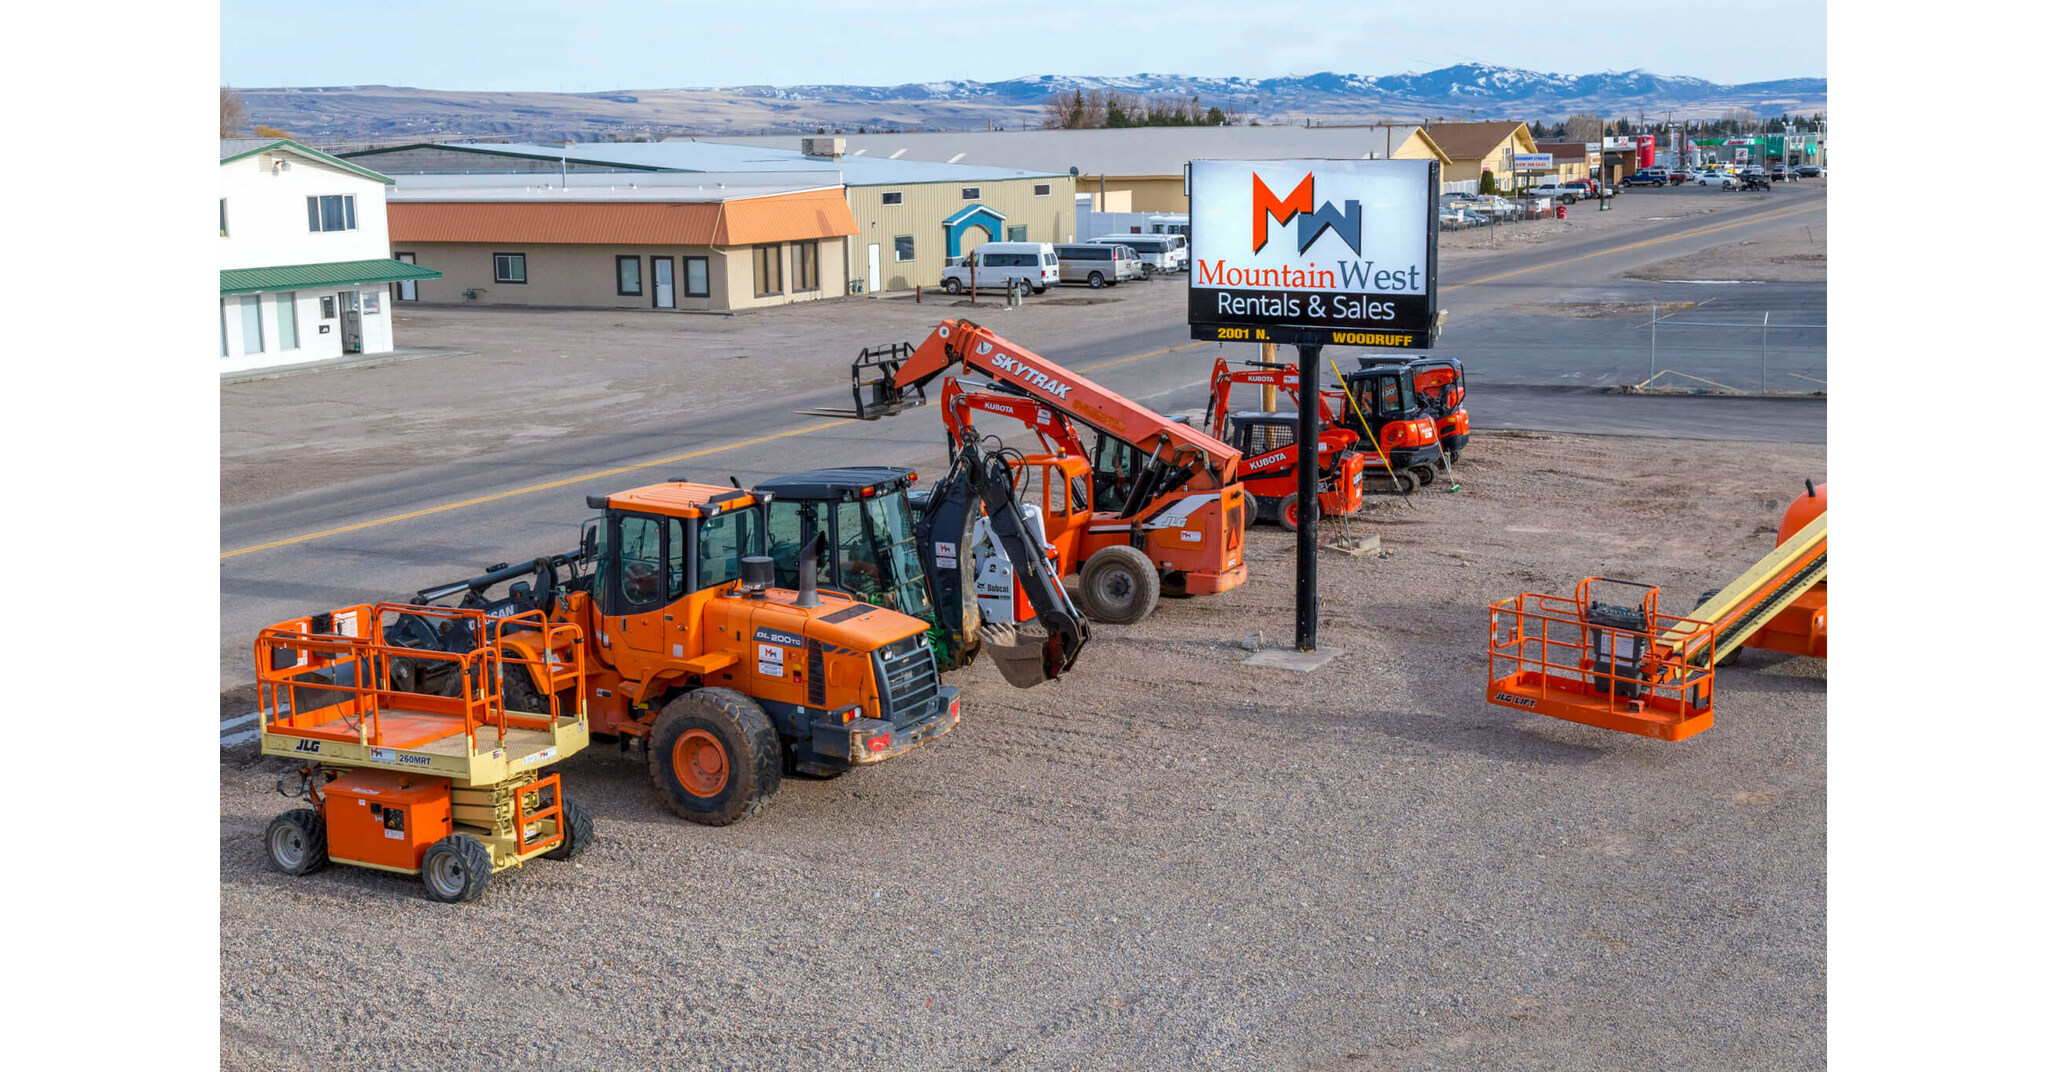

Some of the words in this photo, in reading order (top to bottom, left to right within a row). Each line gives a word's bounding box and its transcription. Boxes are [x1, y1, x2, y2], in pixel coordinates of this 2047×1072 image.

[1217, 292, 1300, 318] Rentals
[1307, 295, 1327, 319] &
[1332, 296, 1396, 321] Sales
[1217, 328, 1250, 340] 2001
[1255, 329, 1271, 341] N.
[1332, 332, 1413, 347] WOODRUFF
[991, 353, 1073, 400] SKYTRAK
[1247, 375, 1275, 383] KUBOTA
[984, 402, 1014, 414] KUBOTA
[1249, 452, 1287, 470] KUBOTA
[987, 584, 1009, 593] Bobcat
[756, 631, 770, 639] DL
[1494, 692, 1512, 703] JLG
[1514, 696, 1536, 707] LIFT
[296, 739, 321, 753] JLG
[399, 754, 431, 766] 260MRT
